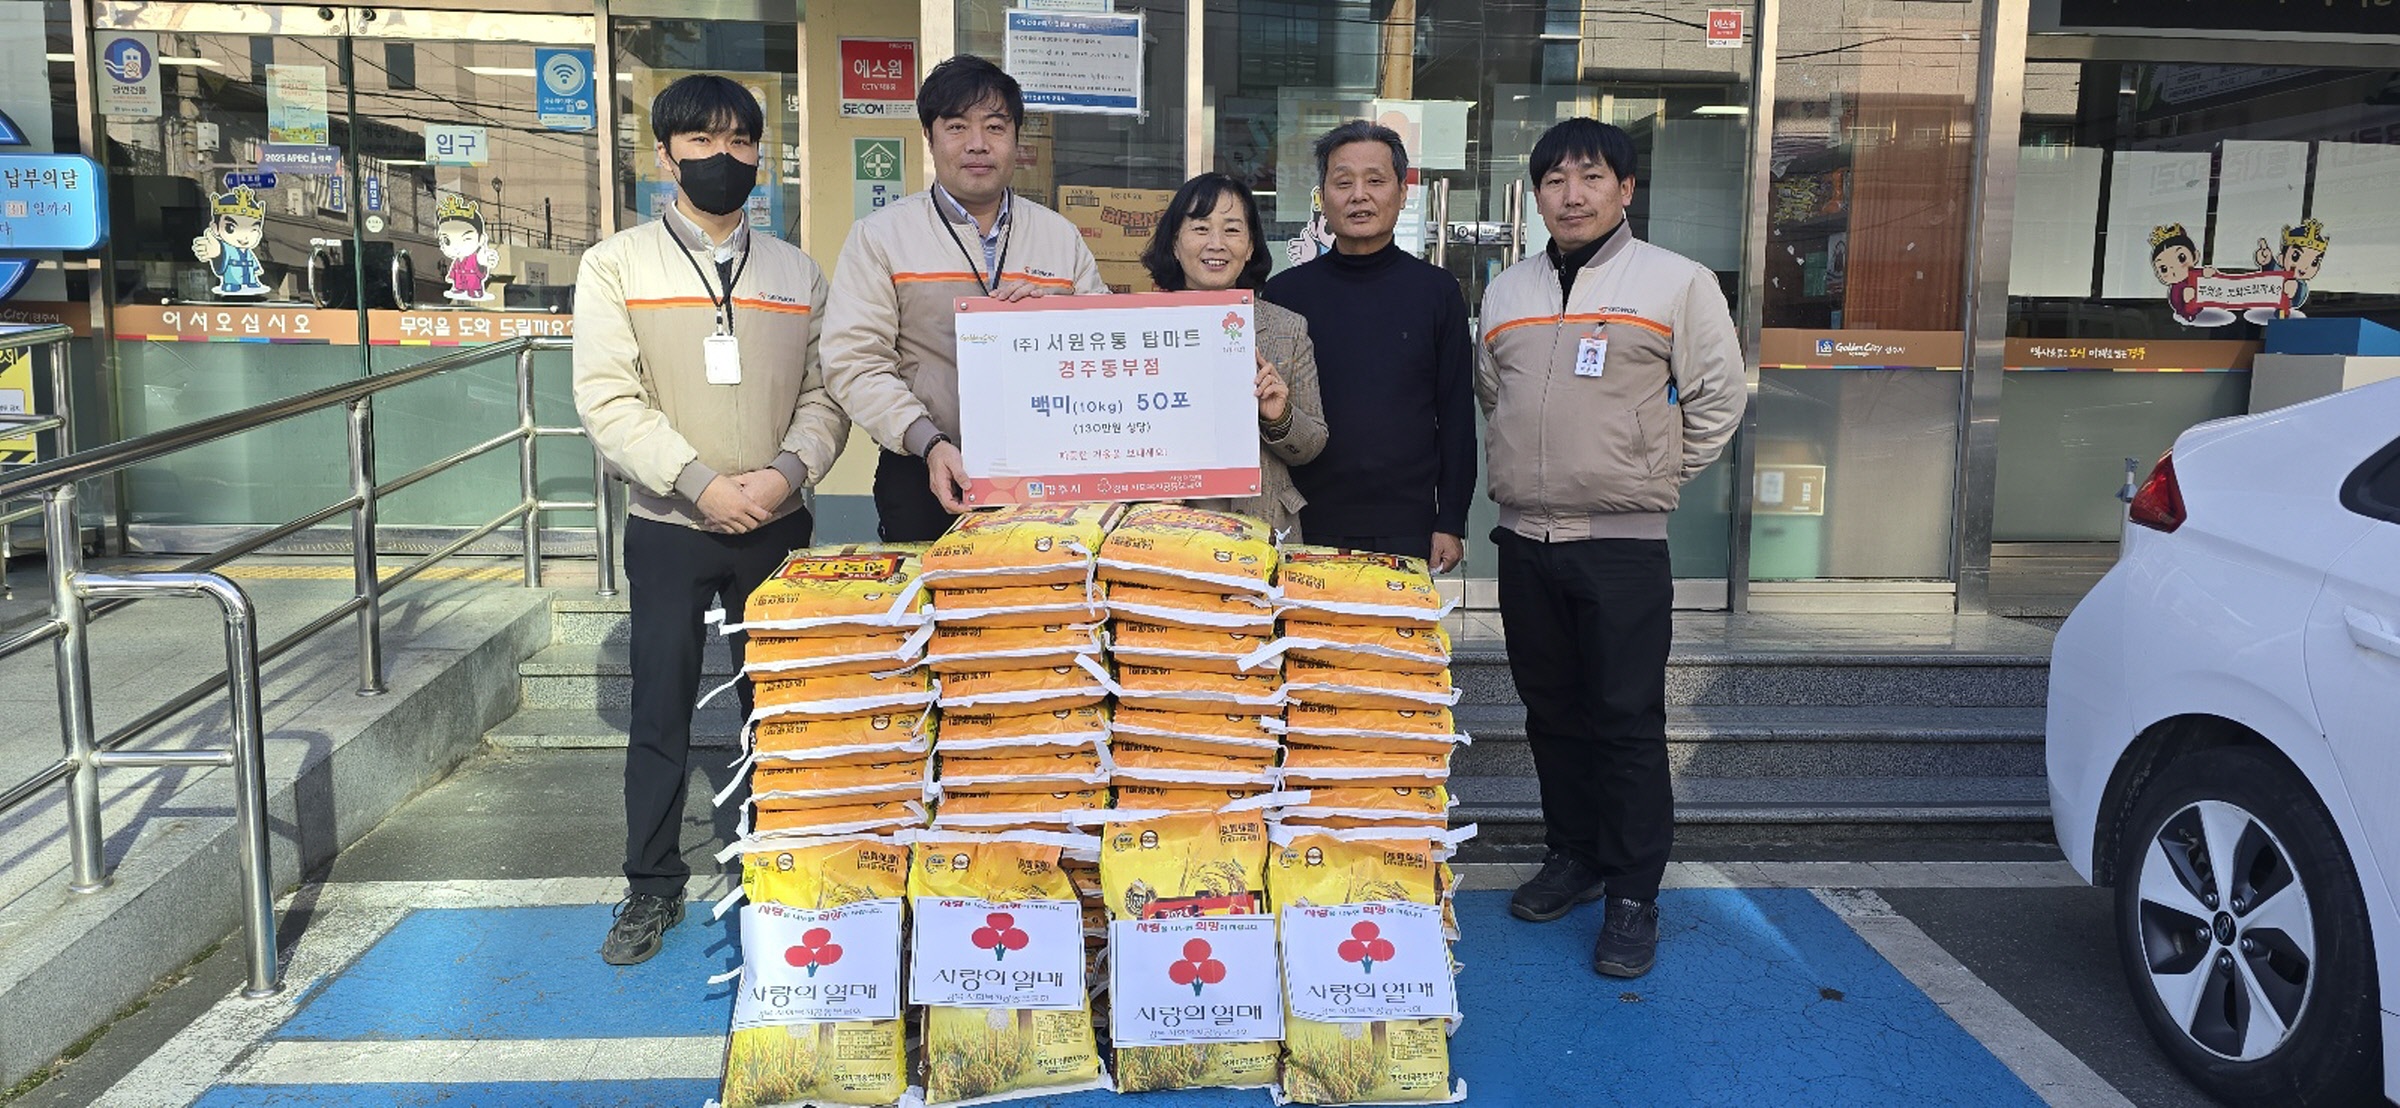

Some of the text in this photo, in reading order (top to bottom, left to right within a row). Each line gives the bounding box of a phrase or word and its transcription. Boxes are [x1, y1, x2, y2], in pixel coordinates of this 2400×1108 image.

[854, 59, 902, 78] 에스원
[843, 103, 884, 114] SECOM
[436, 134, 476, 156] 입구
[265, 153, 285, 163] 2025
[287, 153, 309, 163] APEC
[4, 167, 78, 189] 납부의달
[162, 311, 311, 334] 어서오십시오
[458, 317, 491, 338] 도와
[1013, 337, 1039, 353] (주)
[1047, 331, 1127, 352] 서원유통
[1141, 328, 1201, 349] 탑마트
[1058, 357, 1160, 380] 경주동부점
[1136, 391, 1192, 412] 50포
[1072, 423, 1121, 436] (130만원
[932, 969, 1063, 993] 사랑의 열매
[749, 983, 877, 1008] 사랑의 열매
[1306, 982, 1434, 1006] 사랑의 열매
[1134, 1005, 1262, 1028] 사랑의 열매
